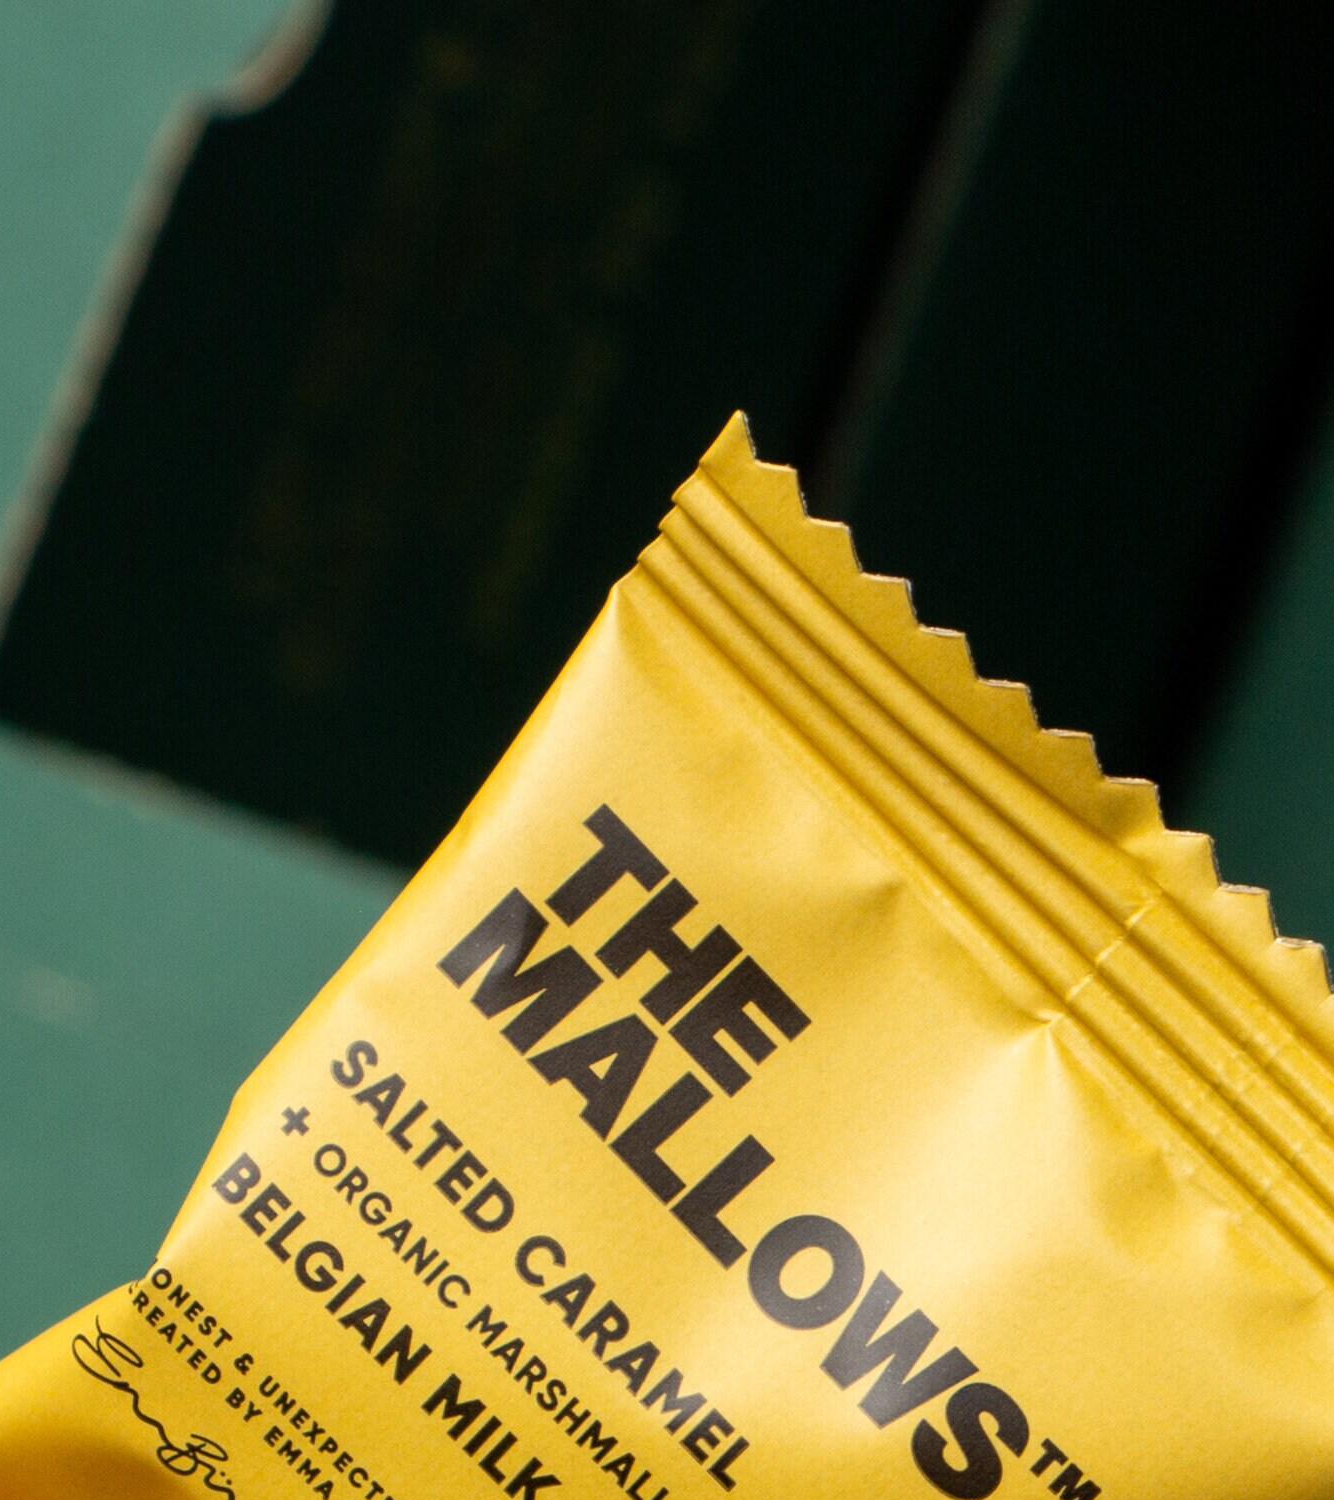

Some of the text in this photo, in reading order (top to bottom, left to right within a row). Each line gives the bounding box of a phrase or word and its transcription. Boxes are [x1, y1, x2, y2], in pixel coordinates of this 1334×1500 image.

[537, 803, 812, 1097] THE
[150, 1257, 233, 1348] ONEST
[233, 1353, 254, 1375] &
[213, 1154, 433, 1385] BELGIAN
[281, 1107, 310, 1137] +
[314, 1143, 471, 1309] ORGANIC
[332, 1040, 750, 1493] SALTED CARAMEL
[225, 1387, 263, 1422] BY
